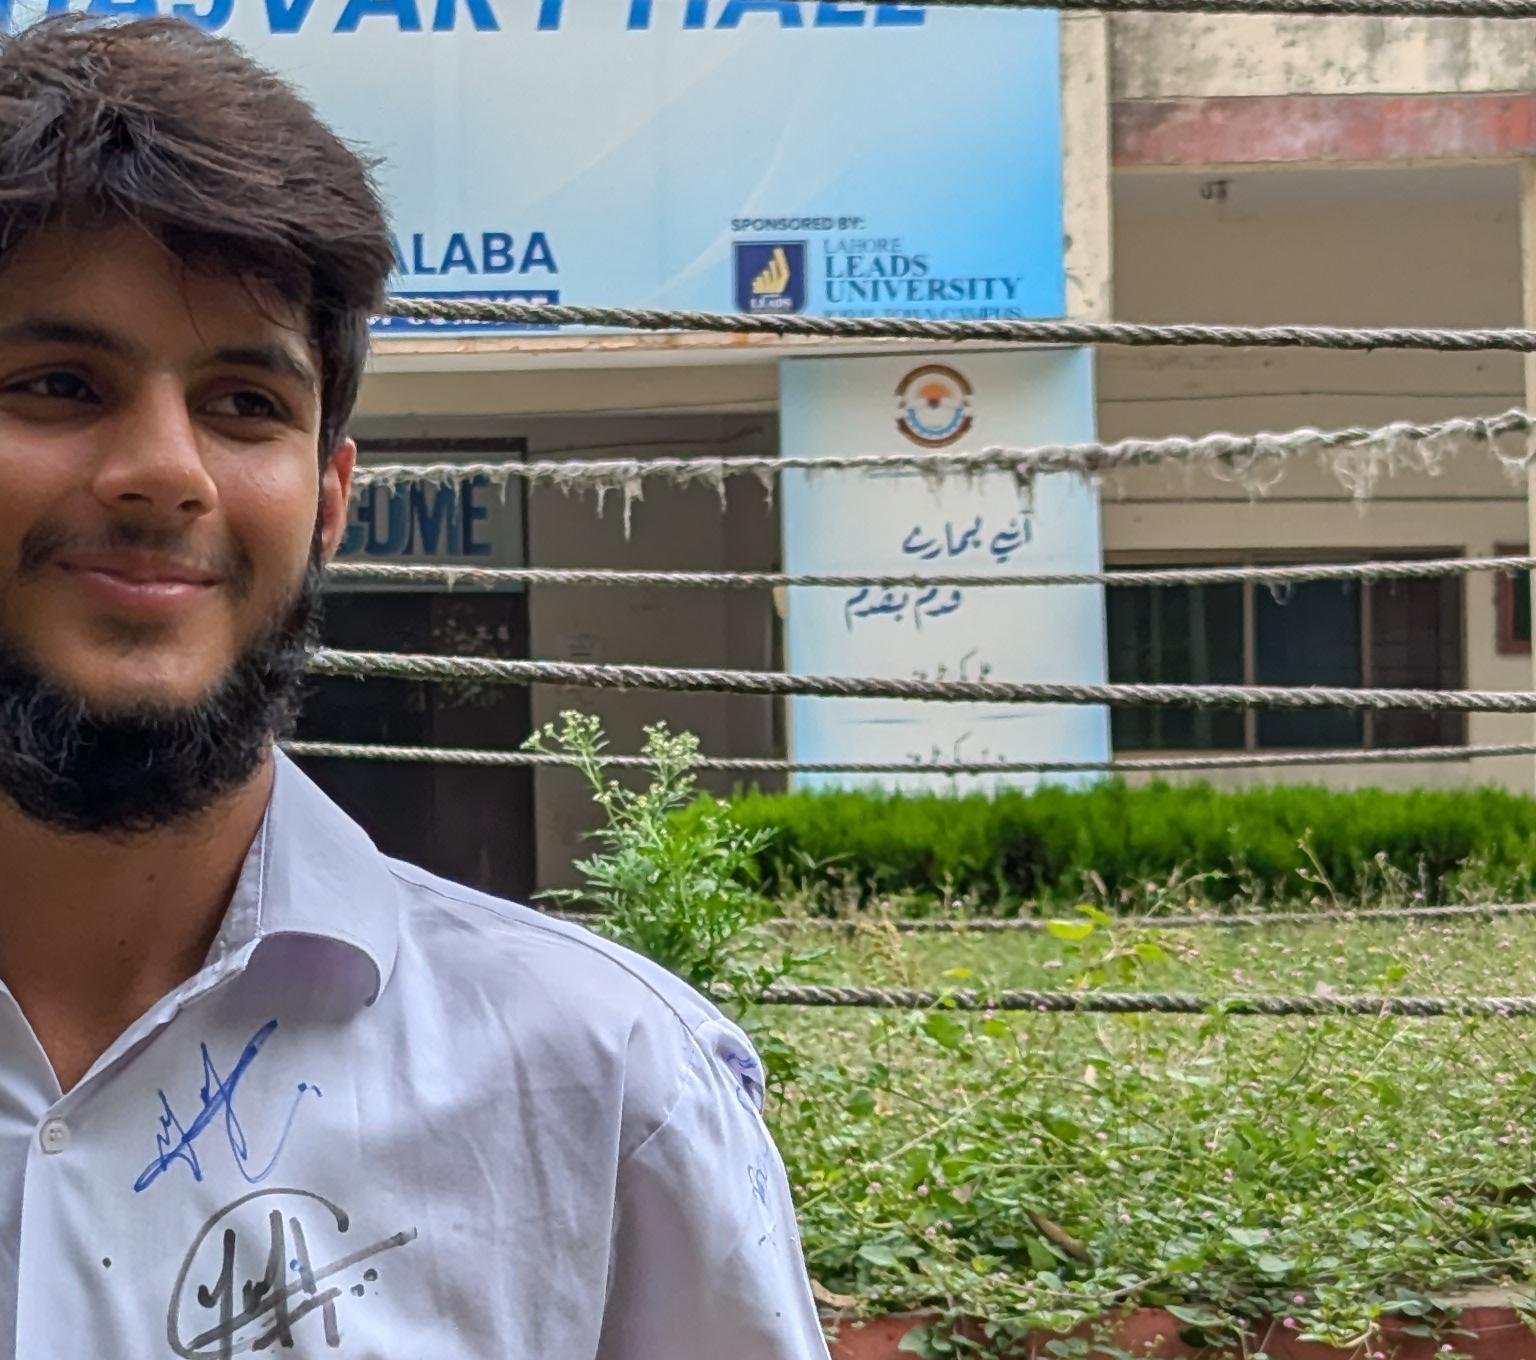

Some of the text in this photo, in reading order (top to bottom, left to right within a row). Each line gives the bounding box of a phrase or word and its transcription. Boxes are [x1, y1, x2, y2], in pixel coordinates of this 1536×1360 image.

[731, 217, 833, 231] SPONSORED
[392, 231, 559, 275] LABA
[823, 237, 902, 254] LAHORE
[825, 253, 929, 279] LEADS
[824, 276, 1021, 303] UNIVERSITY
[339, 475, 493, 556] OME
